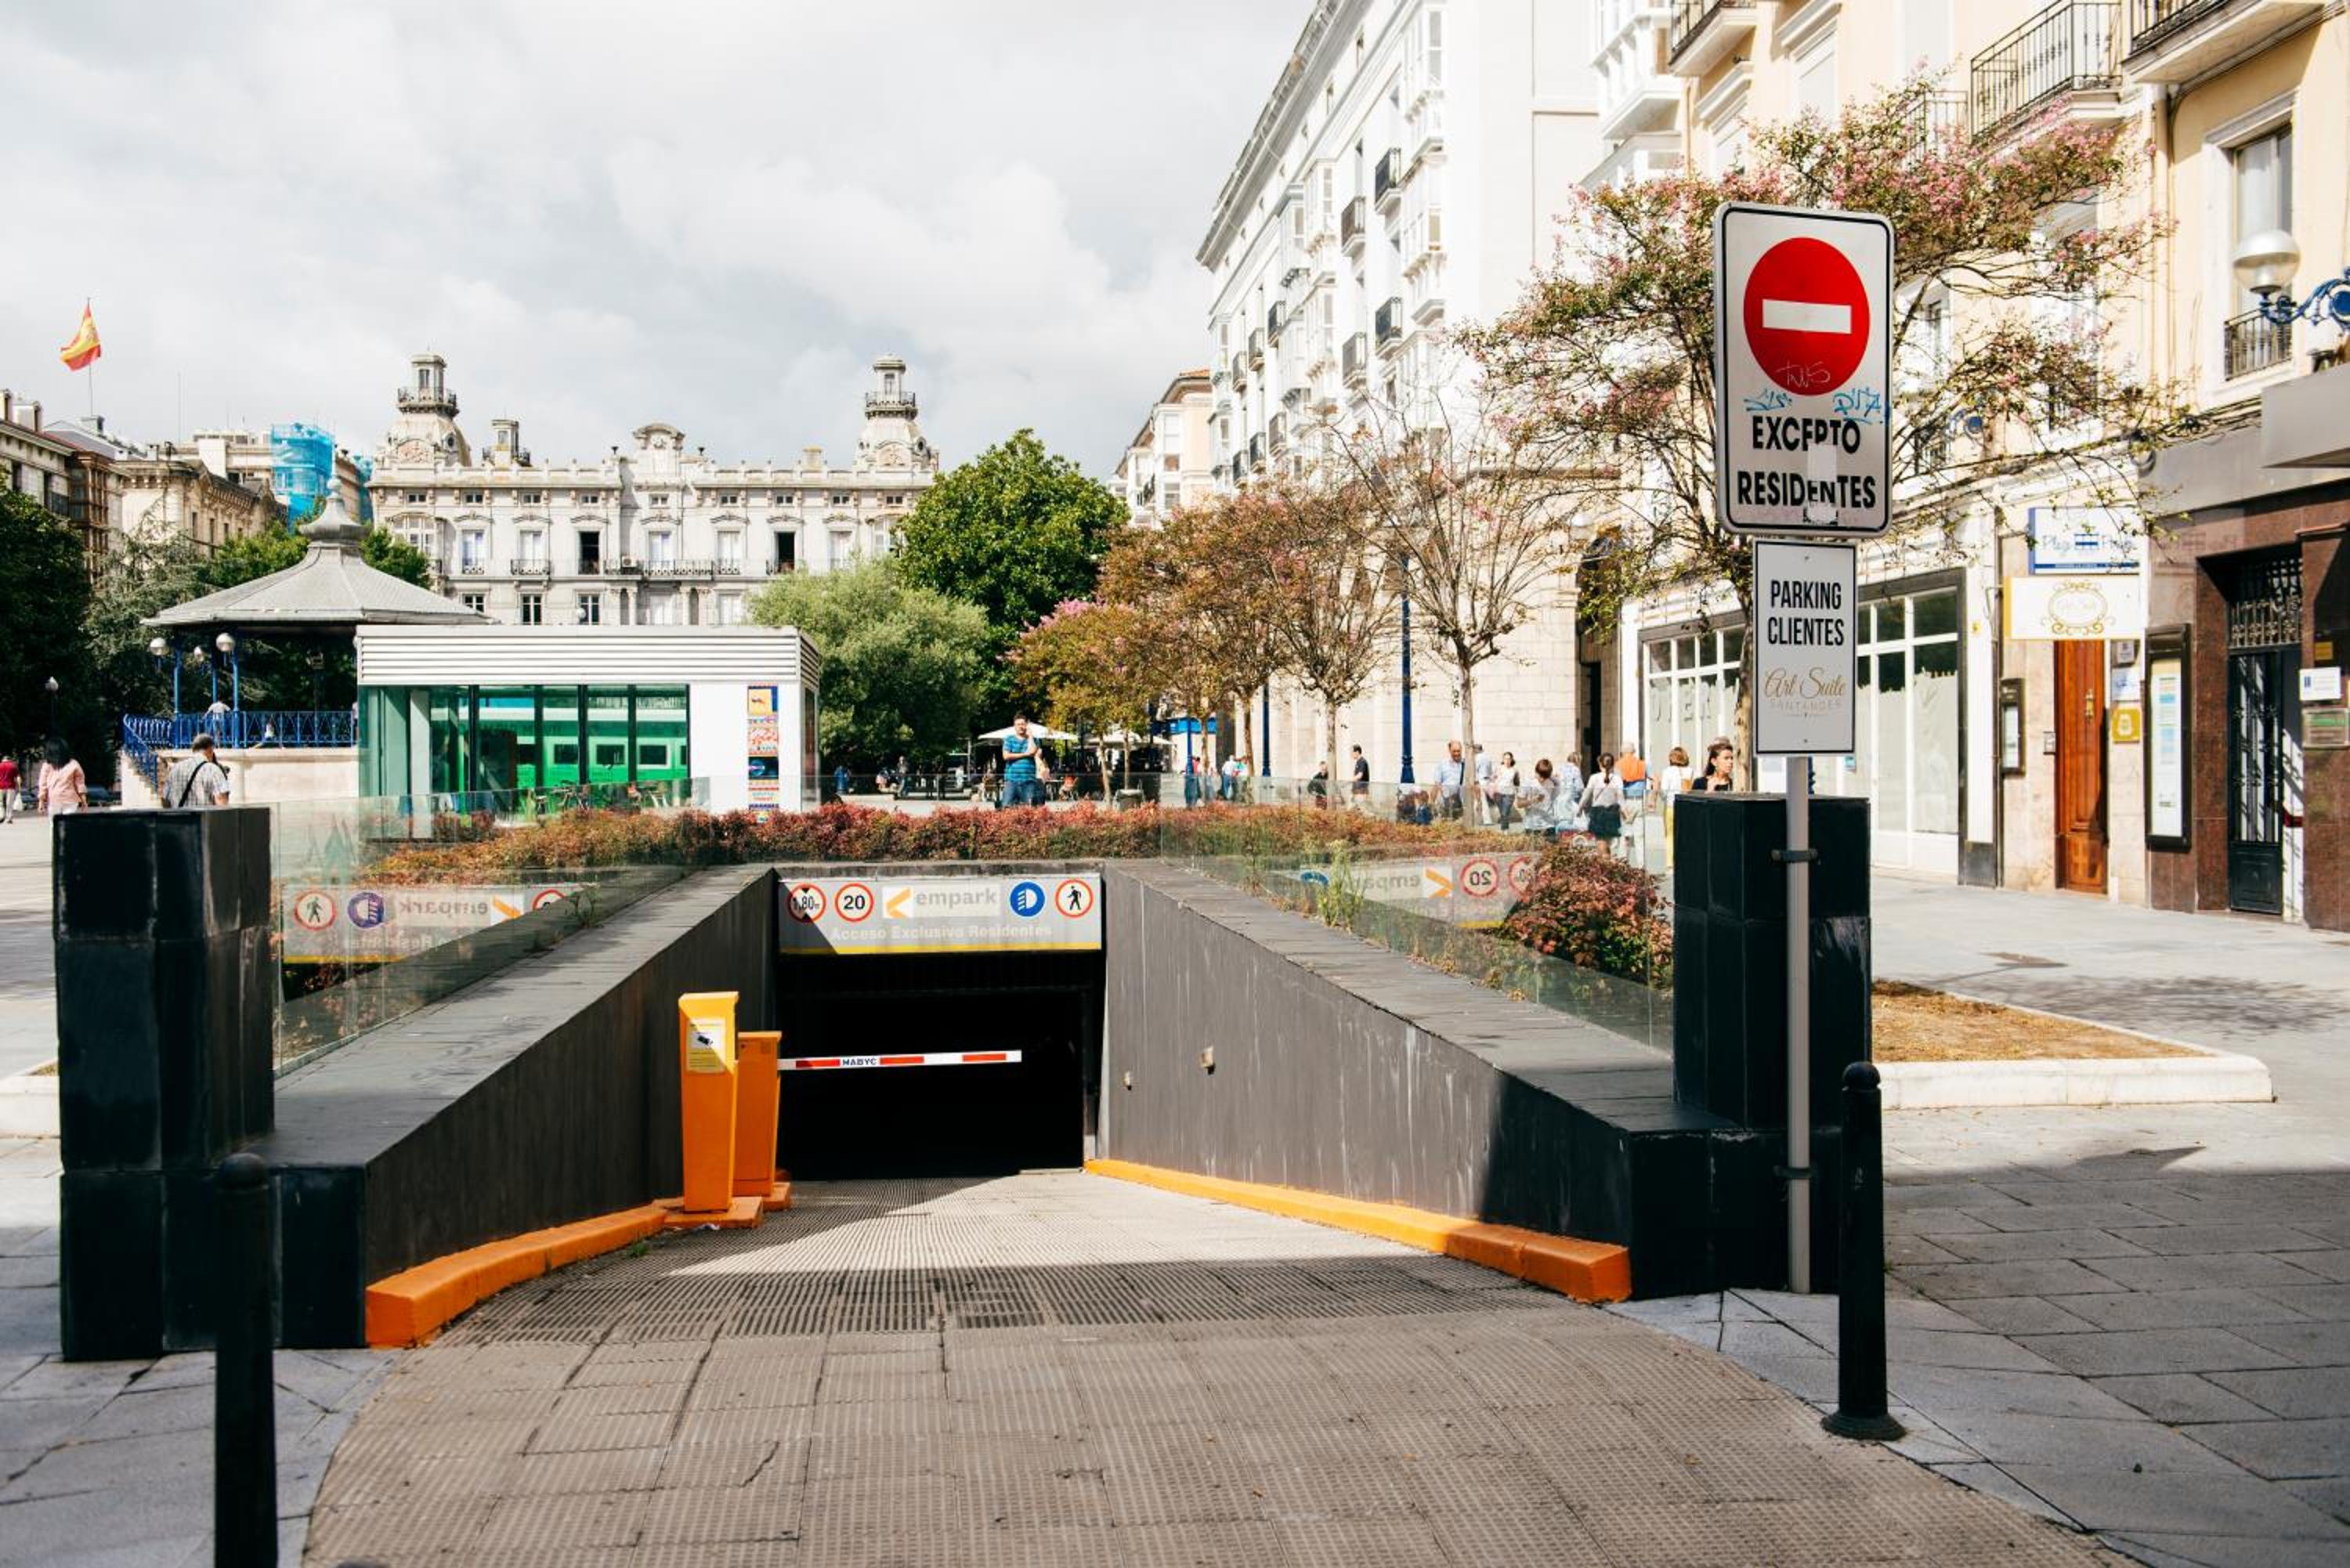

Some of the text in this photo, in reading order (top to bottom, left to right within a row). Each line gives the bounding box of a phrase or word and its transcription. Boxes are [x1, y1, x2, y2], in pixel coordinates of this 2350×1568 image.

[1752, 415, 1860, 454] EXCEPTO
[1737, 471, 1876, 509] RESIDENTES
[1771, 580, 1842, 610] PARKING
[1768, 616, 1845, 646] CLIENTES
[1764, 667, 1846, 699] Art Suite
[844, 894, 866, 910] 20
[916, 887, 997, 909] empark
[832, 926, 887, 940] Acceso
